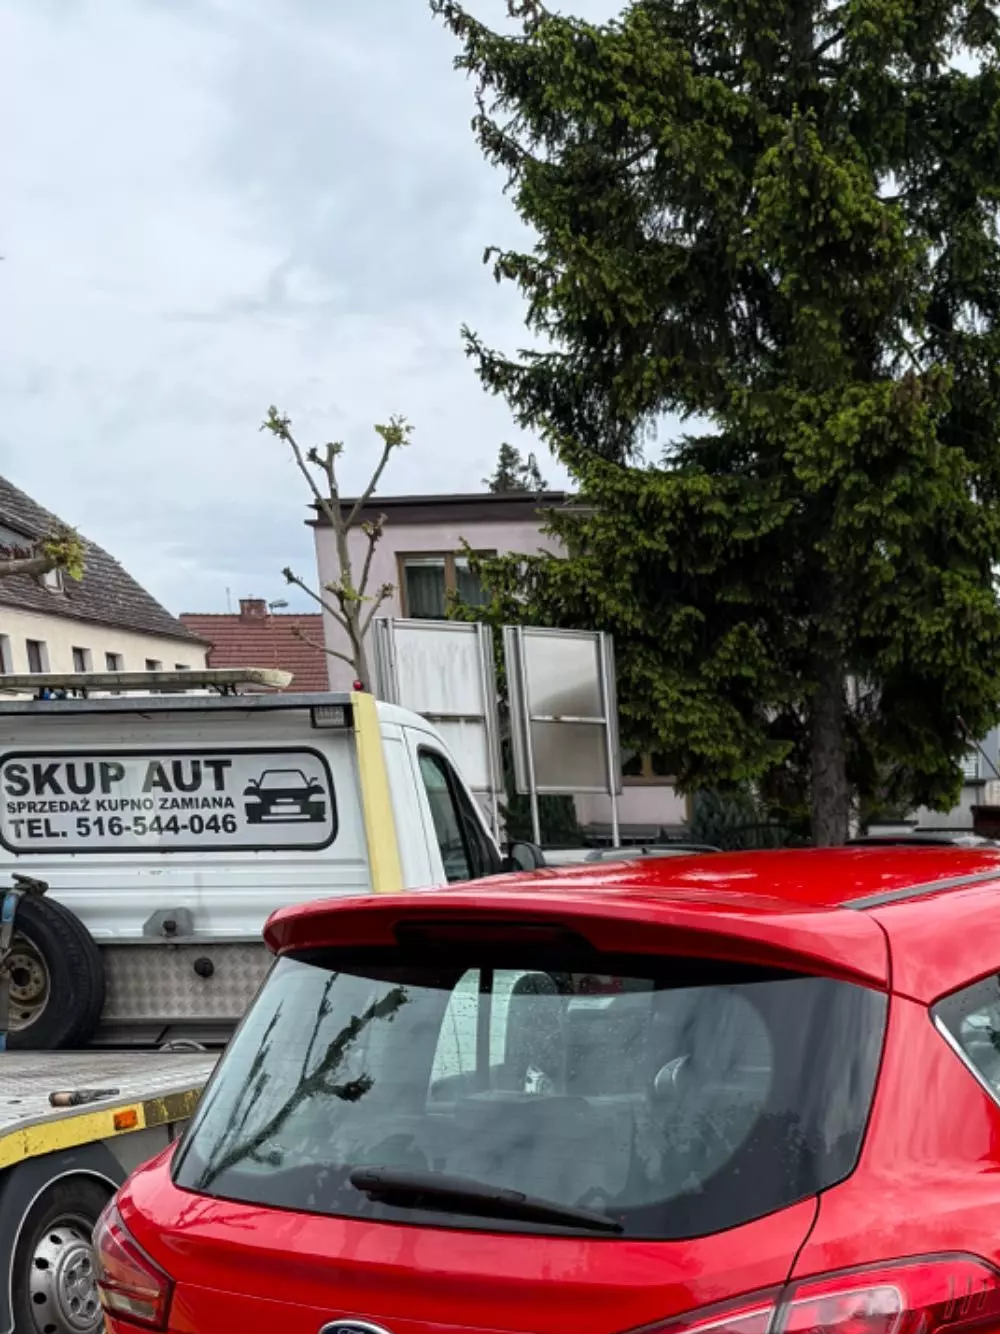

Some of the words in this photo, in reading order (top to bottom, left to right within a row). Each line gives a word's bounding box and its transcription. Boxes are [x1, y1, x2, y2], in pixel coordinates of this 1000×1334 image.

[3, 762, 126, 797] SKUP
[141, 759, 233, 794] AUT
[7, 797, 92, 814] SPRZEDAŻ
[96, 799, 154, 812] KUPNO
[159, 797, 235, 810] ZAMIANA
[9, 818, 68, 839] TEL.
[76, 814, 238, 837] 516-544-046
